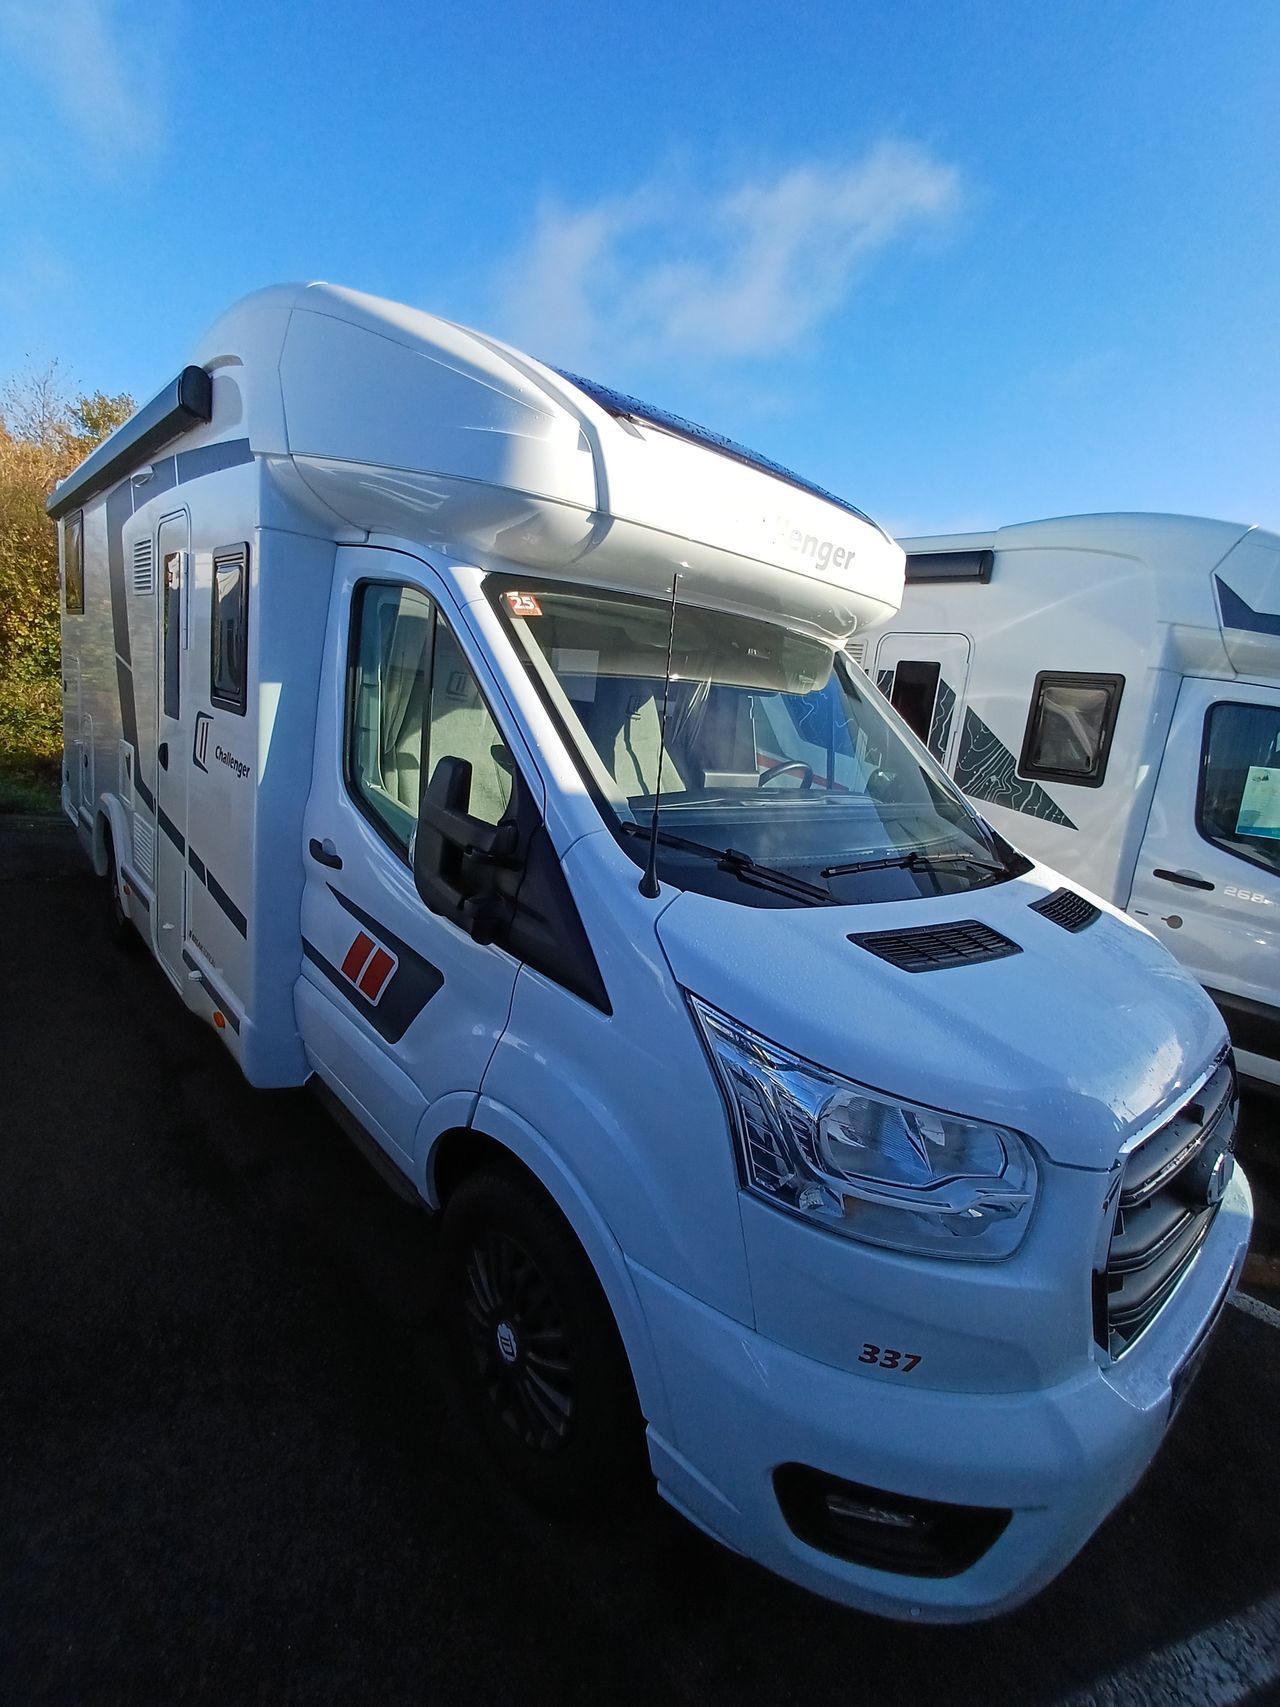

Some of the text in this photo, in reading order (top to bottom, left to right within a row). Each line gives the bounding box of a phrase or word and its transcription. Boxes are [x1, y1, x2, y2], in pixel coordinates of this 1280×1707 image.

[508, 595, 536, 610] 25
[215, 745, 251, 779] Challenger
[857, 1343, 922, 1373] 337
